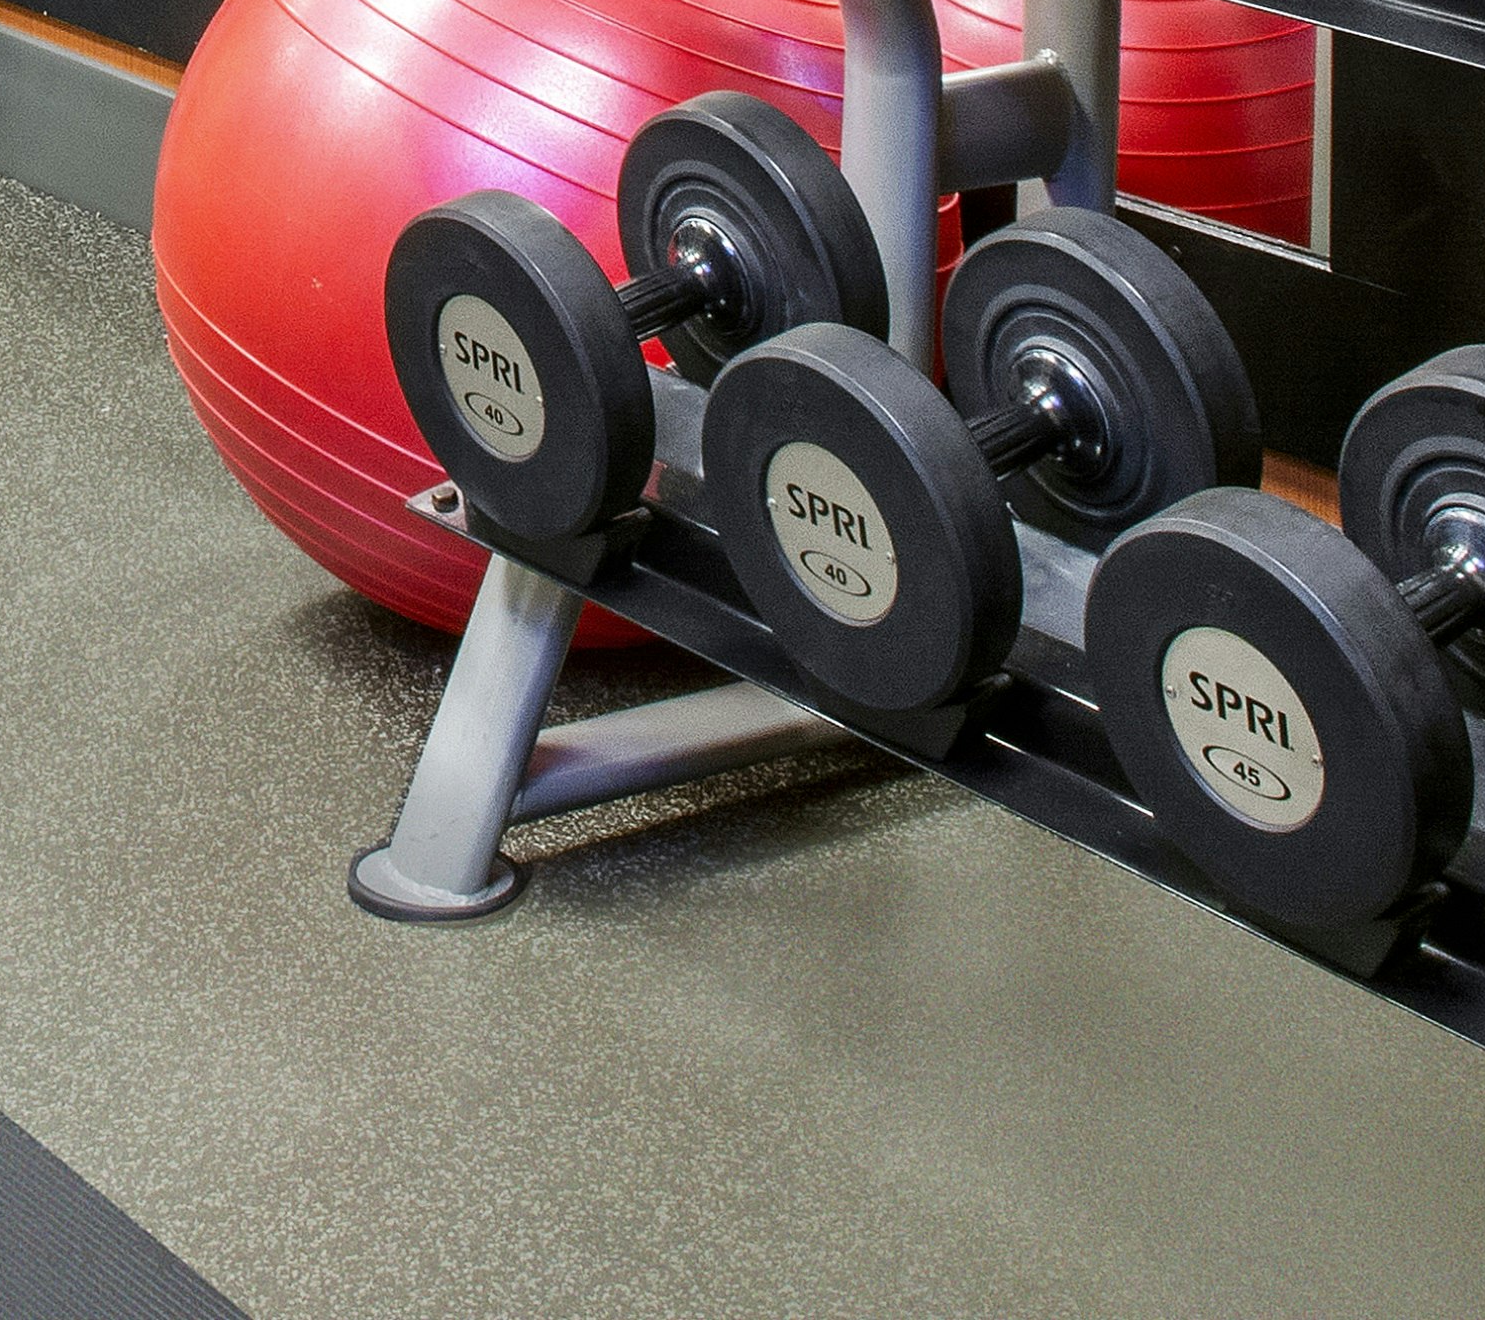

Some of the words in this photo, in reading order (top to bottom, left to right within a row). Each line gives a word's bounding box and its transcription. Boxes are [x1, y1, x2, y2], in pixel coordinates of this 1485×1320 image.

[454, 331, 525, 395] SPRI
[485, 404, 504, 427] 40
[786, 483, 872, 550] SPRI
[824, 564, 847, 586] 40
[1189, 671, 1290, 750] SPRI
[1233, 761, 1260, 787] 45
